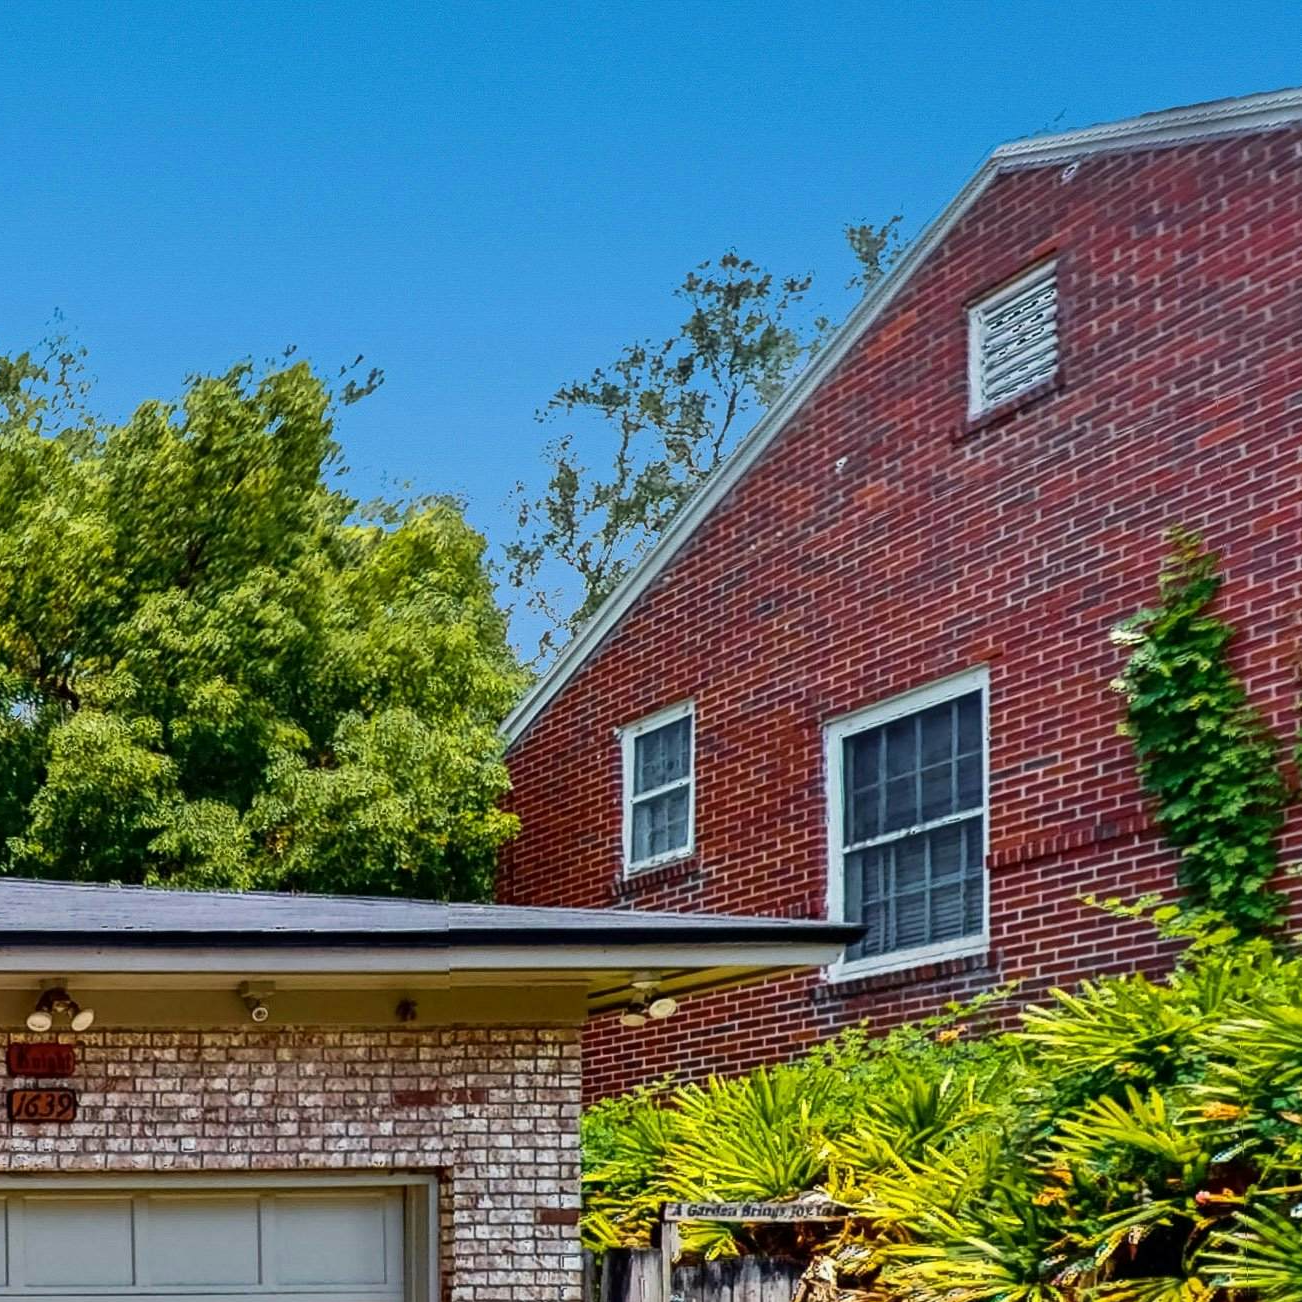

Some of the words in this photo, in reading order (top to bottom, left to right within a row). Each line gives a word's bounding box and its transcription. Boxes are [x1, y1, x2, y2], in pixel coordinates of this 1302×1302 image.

[14, 1093, 72, 1117] 1639
[672, 1204, 682, 1216] A
[687, 1204, 737, 1217] Garden
[740, 1204, 787, 1218] Brings
